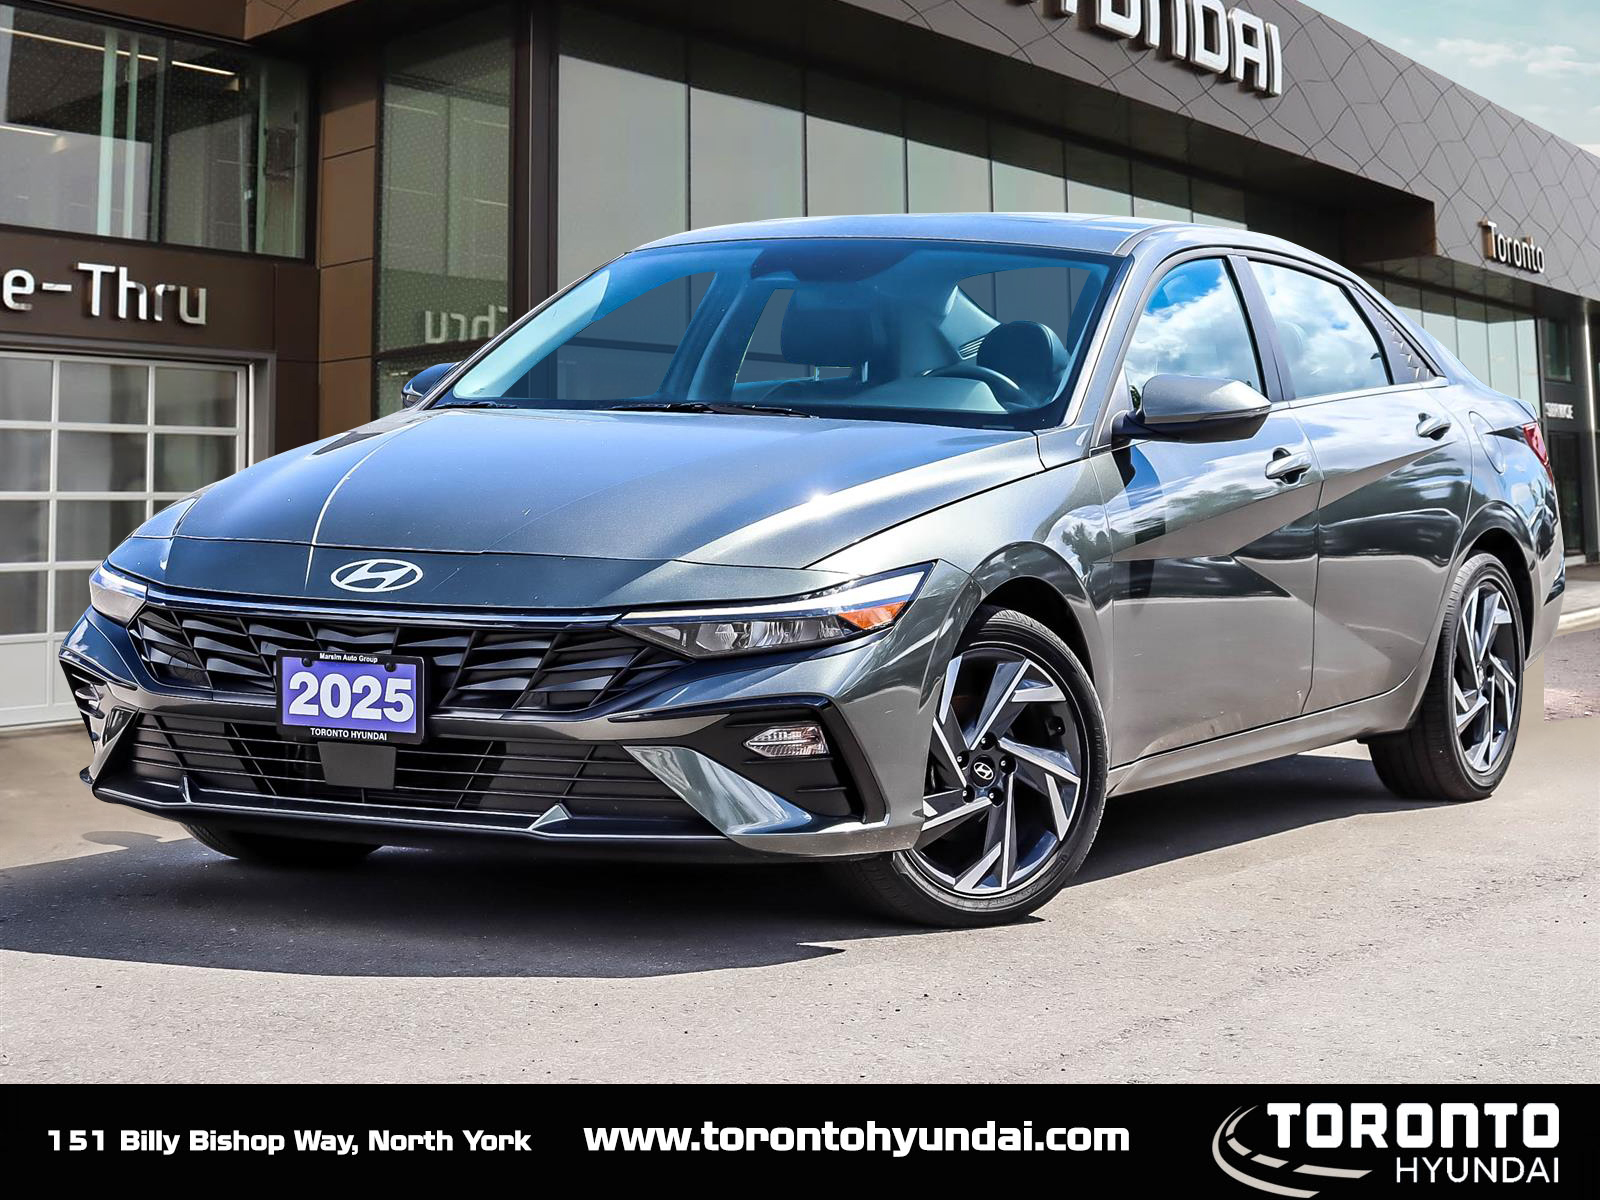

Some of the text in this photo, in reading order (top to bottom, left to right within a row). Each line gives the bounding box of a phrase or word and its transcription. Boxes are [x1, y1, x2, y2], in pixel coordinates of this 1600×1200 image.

[1061, 0, 1282, 97] UNDAI
[1483, 219, 1546, 274] Toronto
[2, 262, 207, 325] e-Thru
[319, 652, 379, 664] Marsim Auto Group
[288, 671, 414, 723] 2025
[310, 727, 388, 741] TORONTO HYUNDAI
